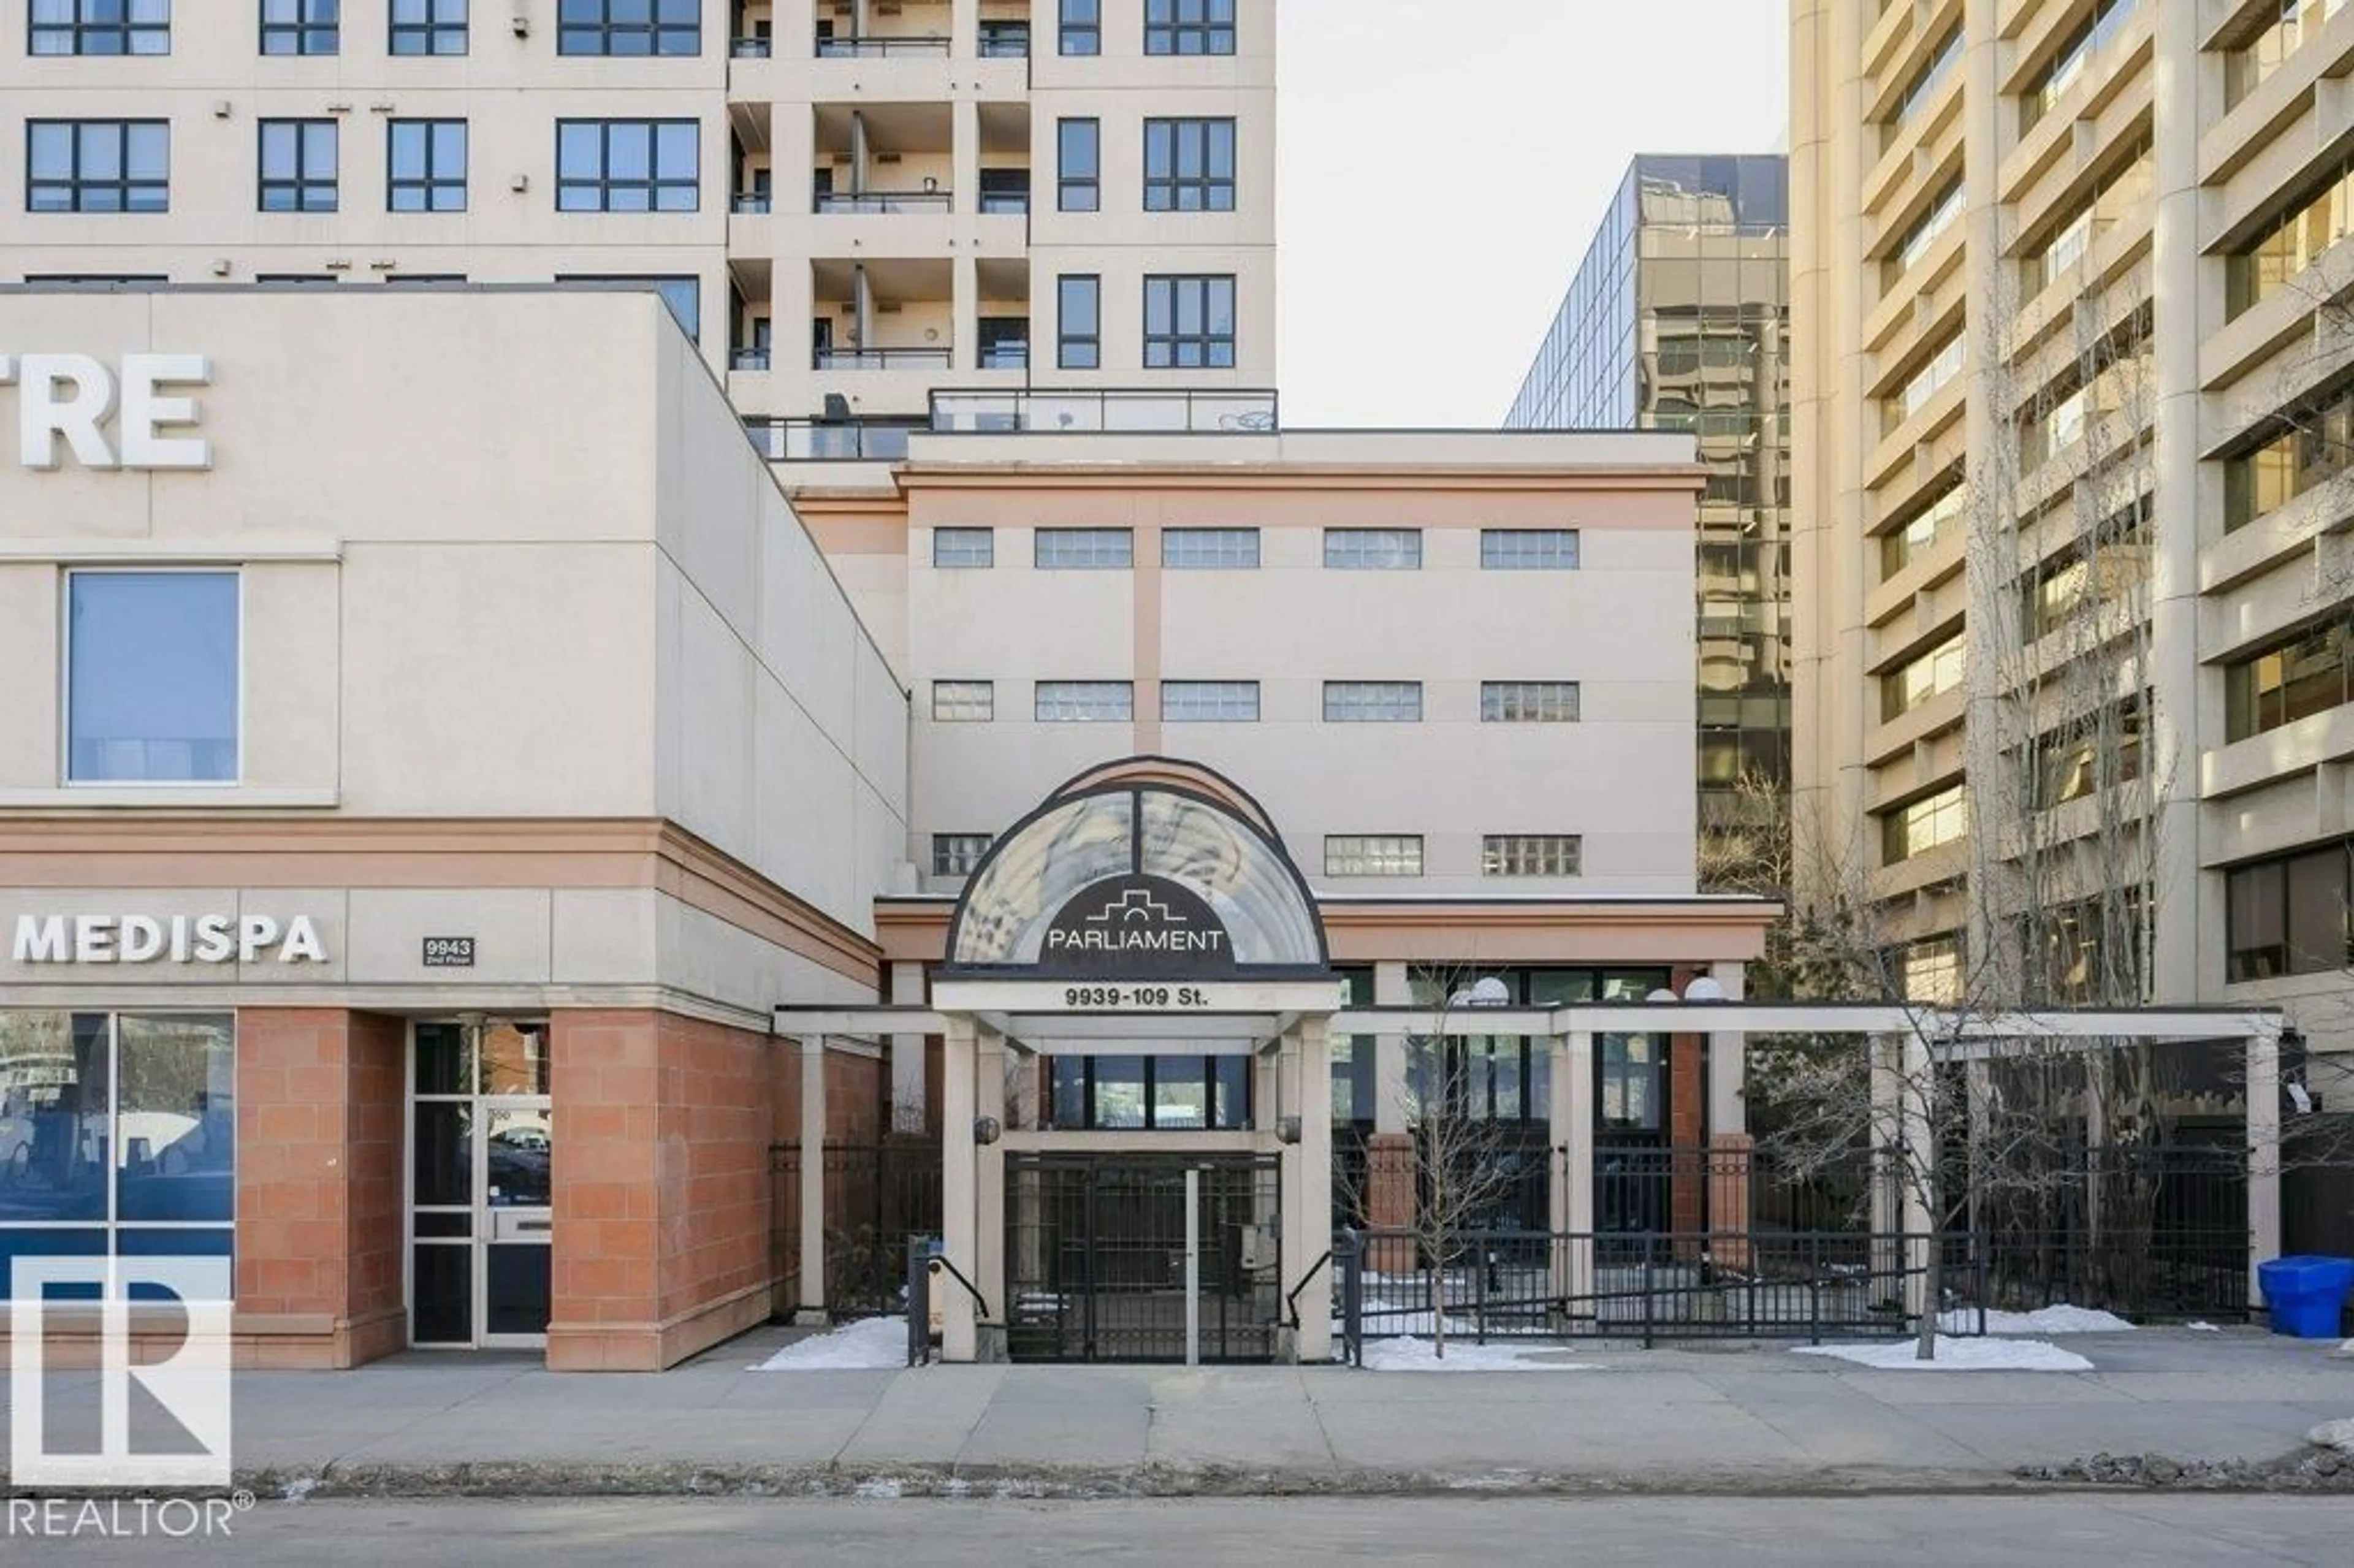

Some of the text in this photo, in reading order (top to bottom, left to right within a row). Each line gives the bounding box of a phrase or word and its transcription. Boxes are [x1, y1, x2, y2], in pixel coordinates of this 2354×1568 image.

[0, 353, 215, 471] RE
[12, 914, 330, 964] MEDISPA
[426, 940, 470, 955] 9943
[1048, 929, 1224, 951] PARLIAMENT
[1065, 988, 1209, 1006] 9939-109 St.
